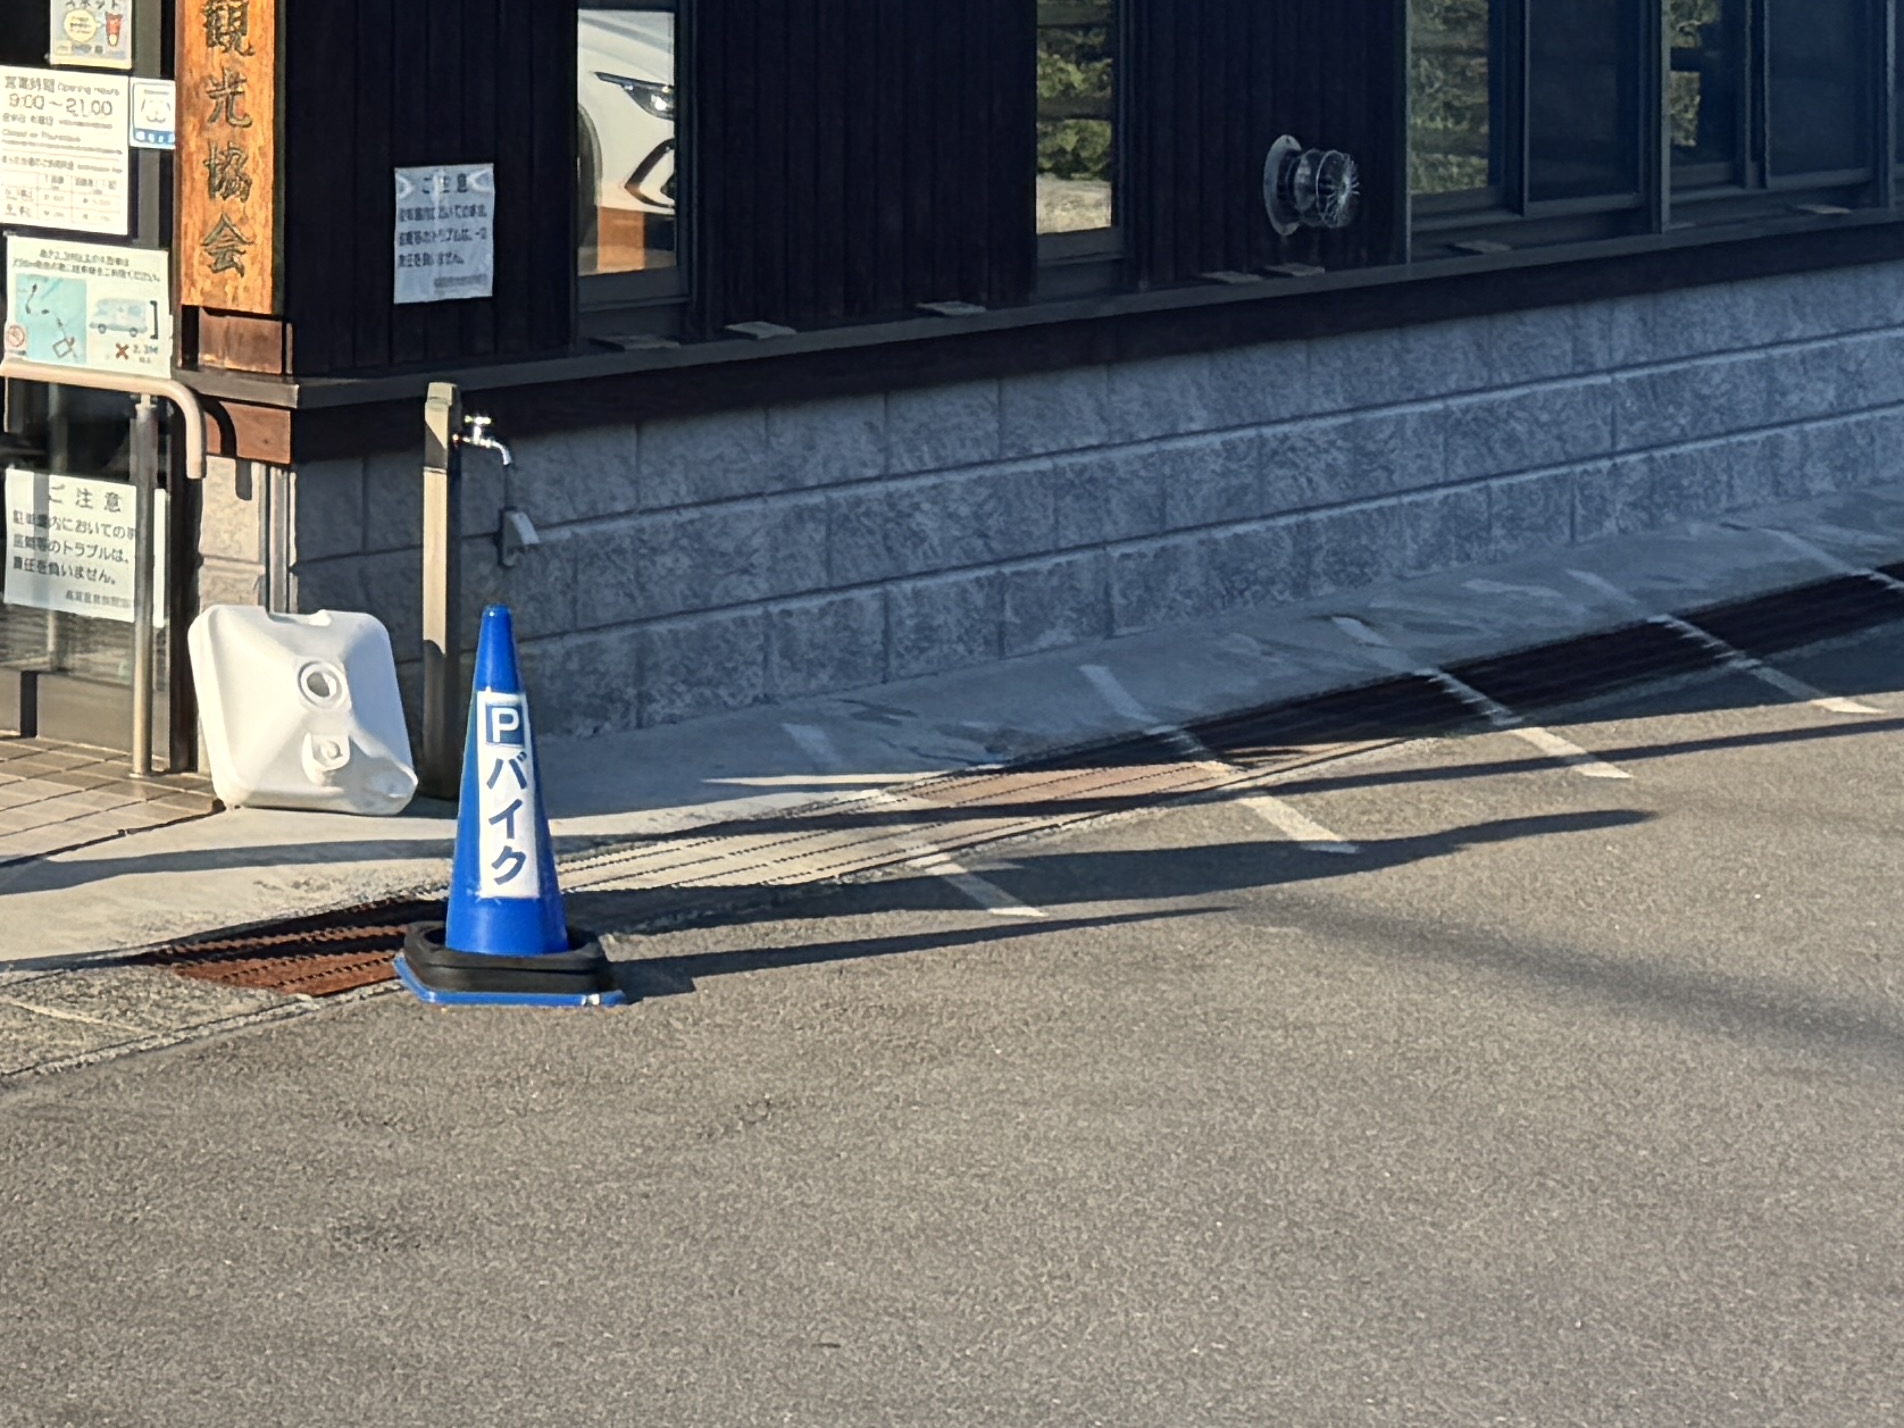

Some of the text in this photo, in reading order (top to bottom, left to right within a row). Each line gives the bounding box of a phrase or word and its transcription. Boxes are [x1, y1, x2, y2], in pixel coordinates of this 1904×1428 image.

[48, 483, 123, 513] ご注意
[491, 707, 520, 743] P
[485, 751, 528, 886] バイク
